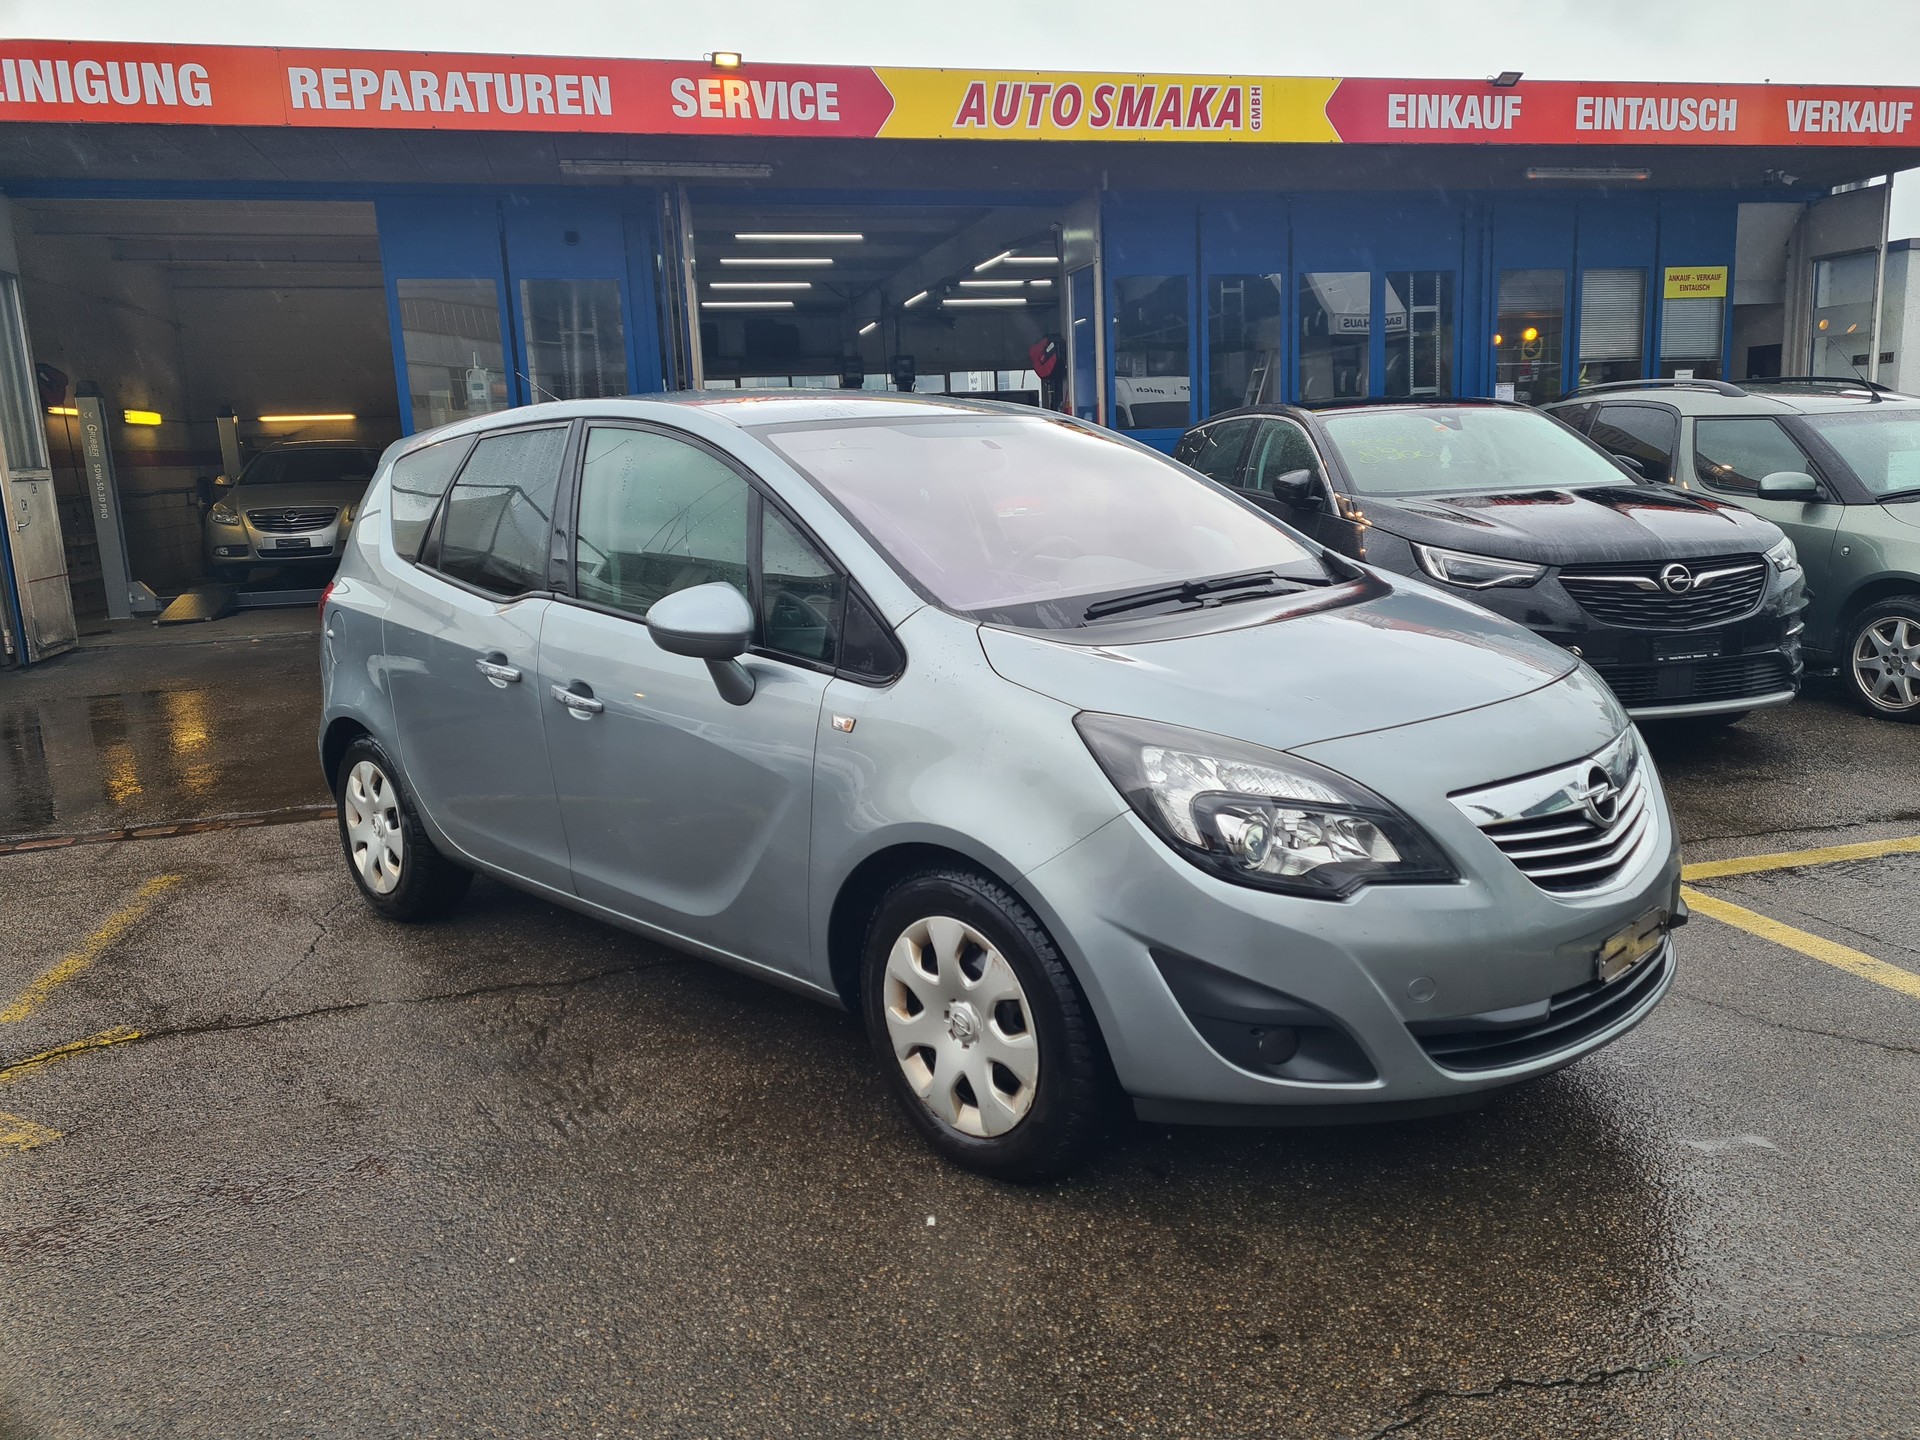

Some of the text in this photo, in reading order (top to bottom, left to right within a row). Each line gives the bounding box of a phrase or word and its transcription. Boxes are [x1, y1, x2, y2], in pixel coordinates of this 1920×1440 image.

[0, 58, 213, 107] INIGUNG
[287, 66, 613, 115] REPARATUREN
[670, 77, 841, 121] SERVICE
[952, 81, 1244, 130] AUTO SMAKA
[1249, 85, 1263, 132] GMBH
[1388, 93, 1523, 130] EINKAUF
[1575, 96, 1738, 132] EINTAUSCH
[1786, 99, 1914, 133] VERKAUF
[1696, 273, 1722, 281] VERKAUF
[100, 503, 109, 519] PRO
